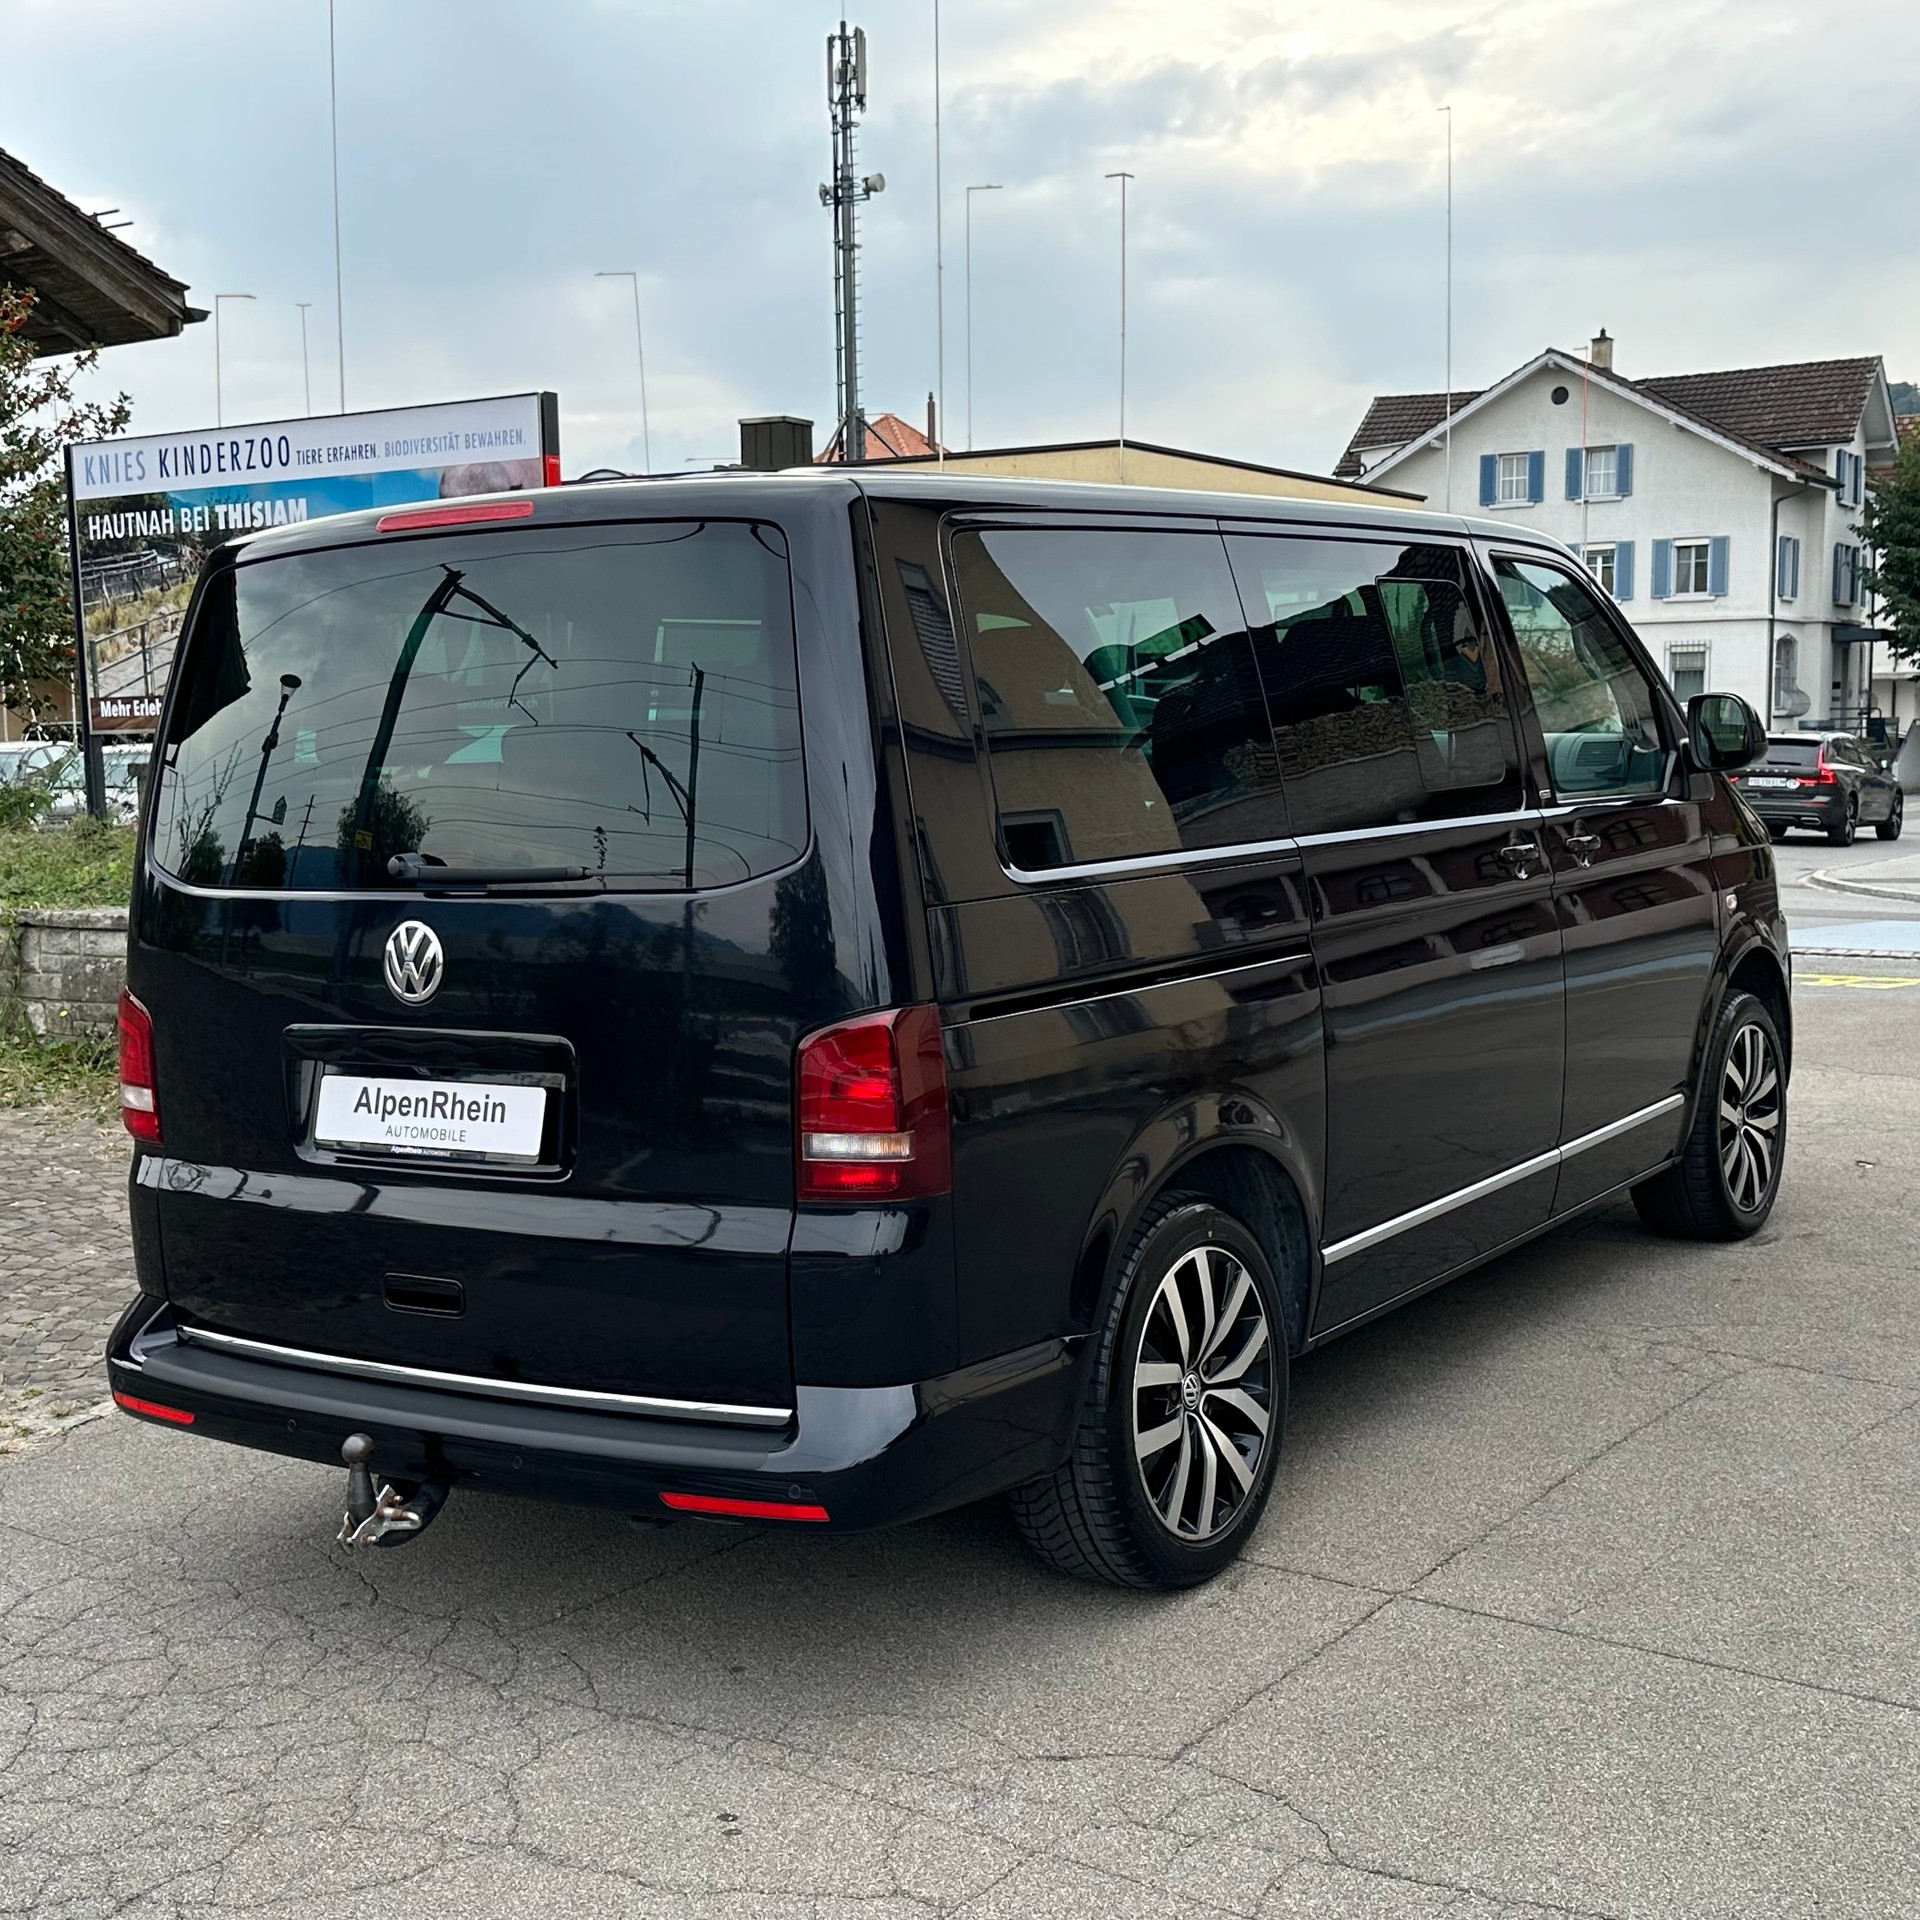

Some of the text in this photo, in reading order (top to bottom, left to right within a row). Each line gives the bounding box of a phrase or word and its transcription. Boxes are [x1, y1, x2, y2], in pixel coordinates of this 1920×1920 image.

[85, 428, 527, 486] KNIES KINDERZOO TIERE ERFAHREN. BIODIVERSITÄT BEWAHREN.
[88, 498, 308, 541] HAUTNAH BEI THISIAM
[100, 699, 132, 717] Mehr
[353, 1086, 506, 1123] AlpenRhein
[385, 1124, 467, 1142] AUTOMOBILE
